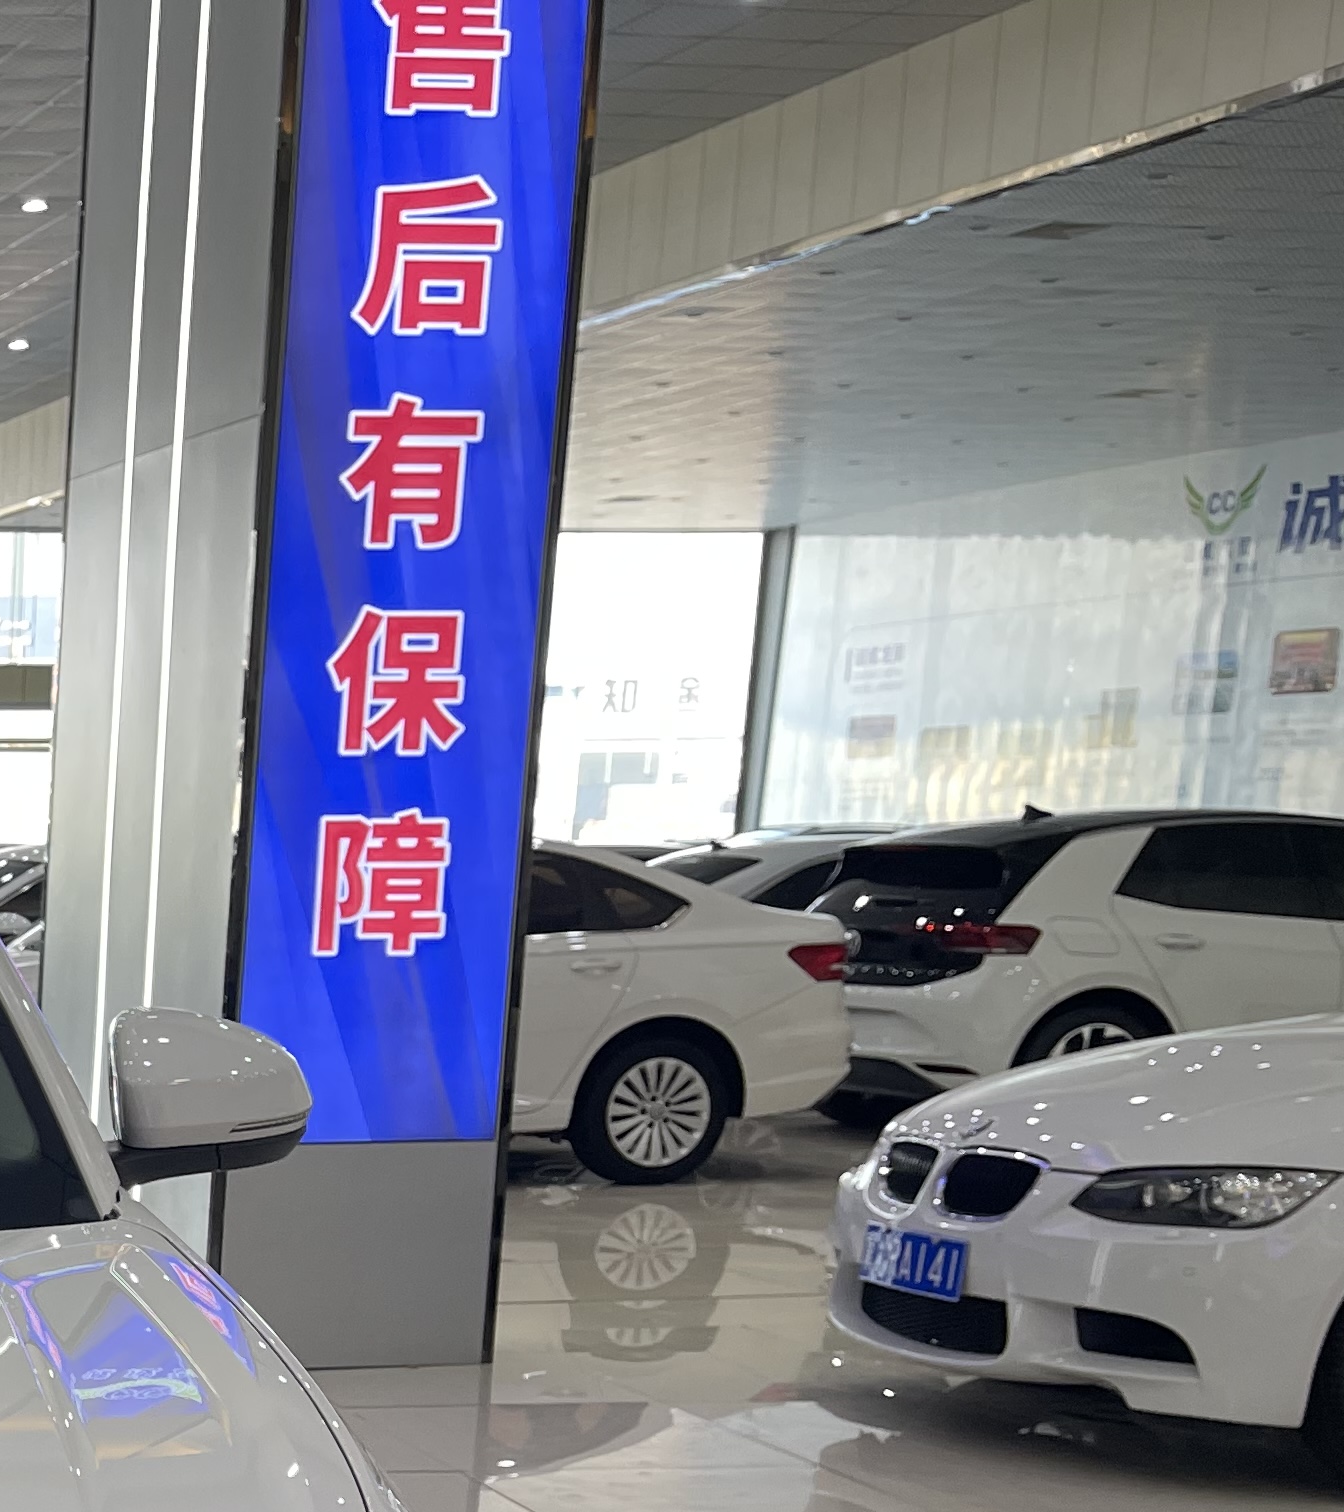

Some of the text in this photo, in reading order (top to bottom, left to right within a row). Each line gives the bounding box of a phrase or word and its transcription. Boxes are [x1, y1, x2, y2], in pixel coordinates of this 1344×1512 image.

[311, 0, 512, 957] 售后有保障
